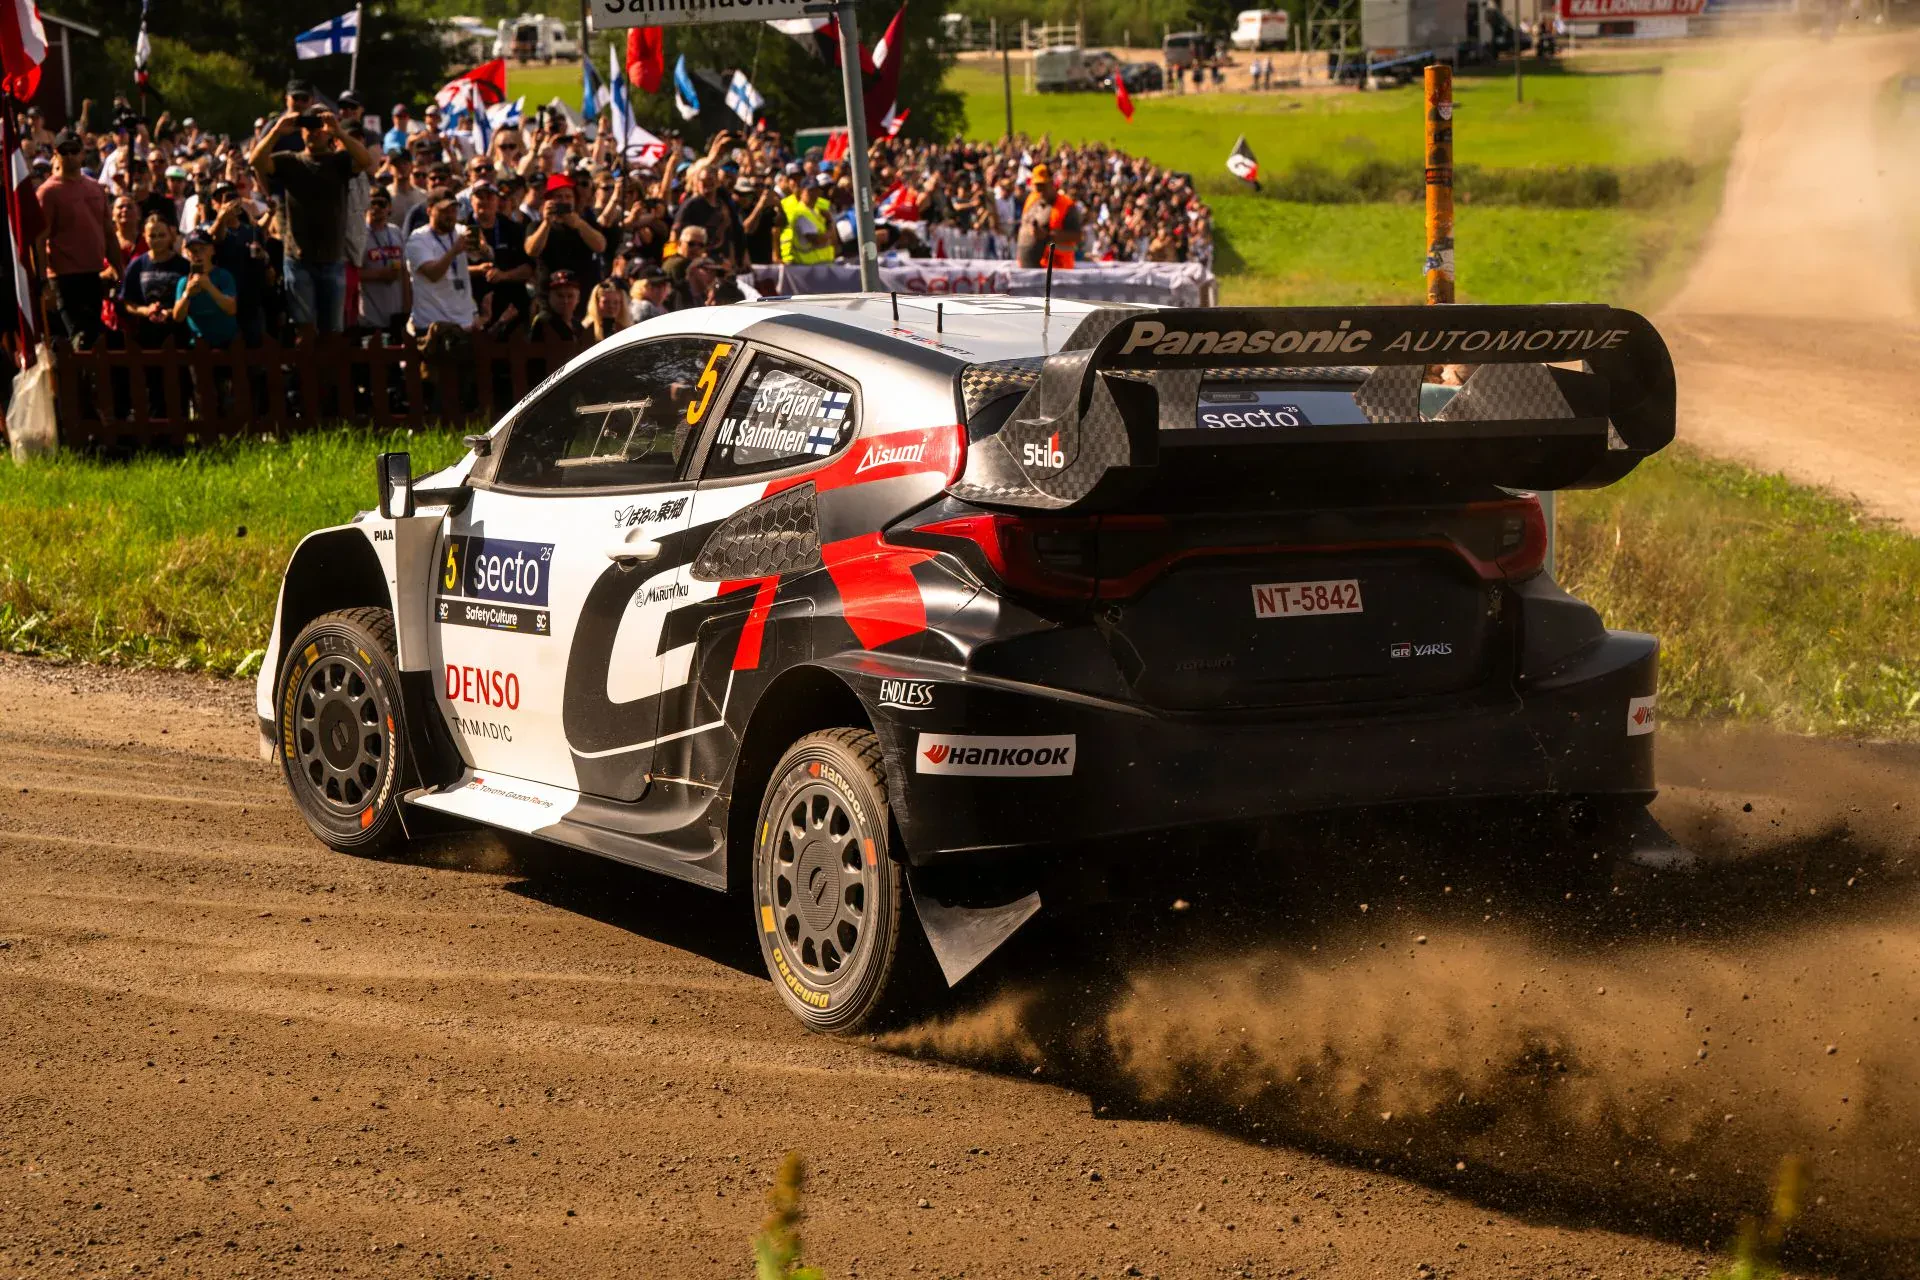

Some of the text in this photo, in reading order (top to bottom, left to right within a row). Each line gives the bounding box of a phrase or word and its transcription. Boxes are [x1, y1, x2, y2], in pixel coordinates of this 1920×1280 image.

[1119, 319, 1630, 355] Panasonic AUTOMOTIVE
[686, 343, 734, 425] 5
[756, 387, 824, 421] S.Pajari
[1202, 408, 1299, 428] secto
[716, 417, 806, 453] M.Salminen
[855, 437, 928, 474] Aisumi
[1023, 437, 1065, 468] Stilo
[374, 529, 394, 542] PIAA
[445, 543, 459, 590] 5
[473, 550, 539, 596] secto
[1256, 583, 1360, 613] NT-5842
[465, 605, 518, 626] SafetyCulture
[1413, 642, 1452, 656] YARIS
[446, 663, 520, 710] DENSO
[879, 679, 935, 706] ENDLESS
[452, 717, 513, 743] TAMADIC
